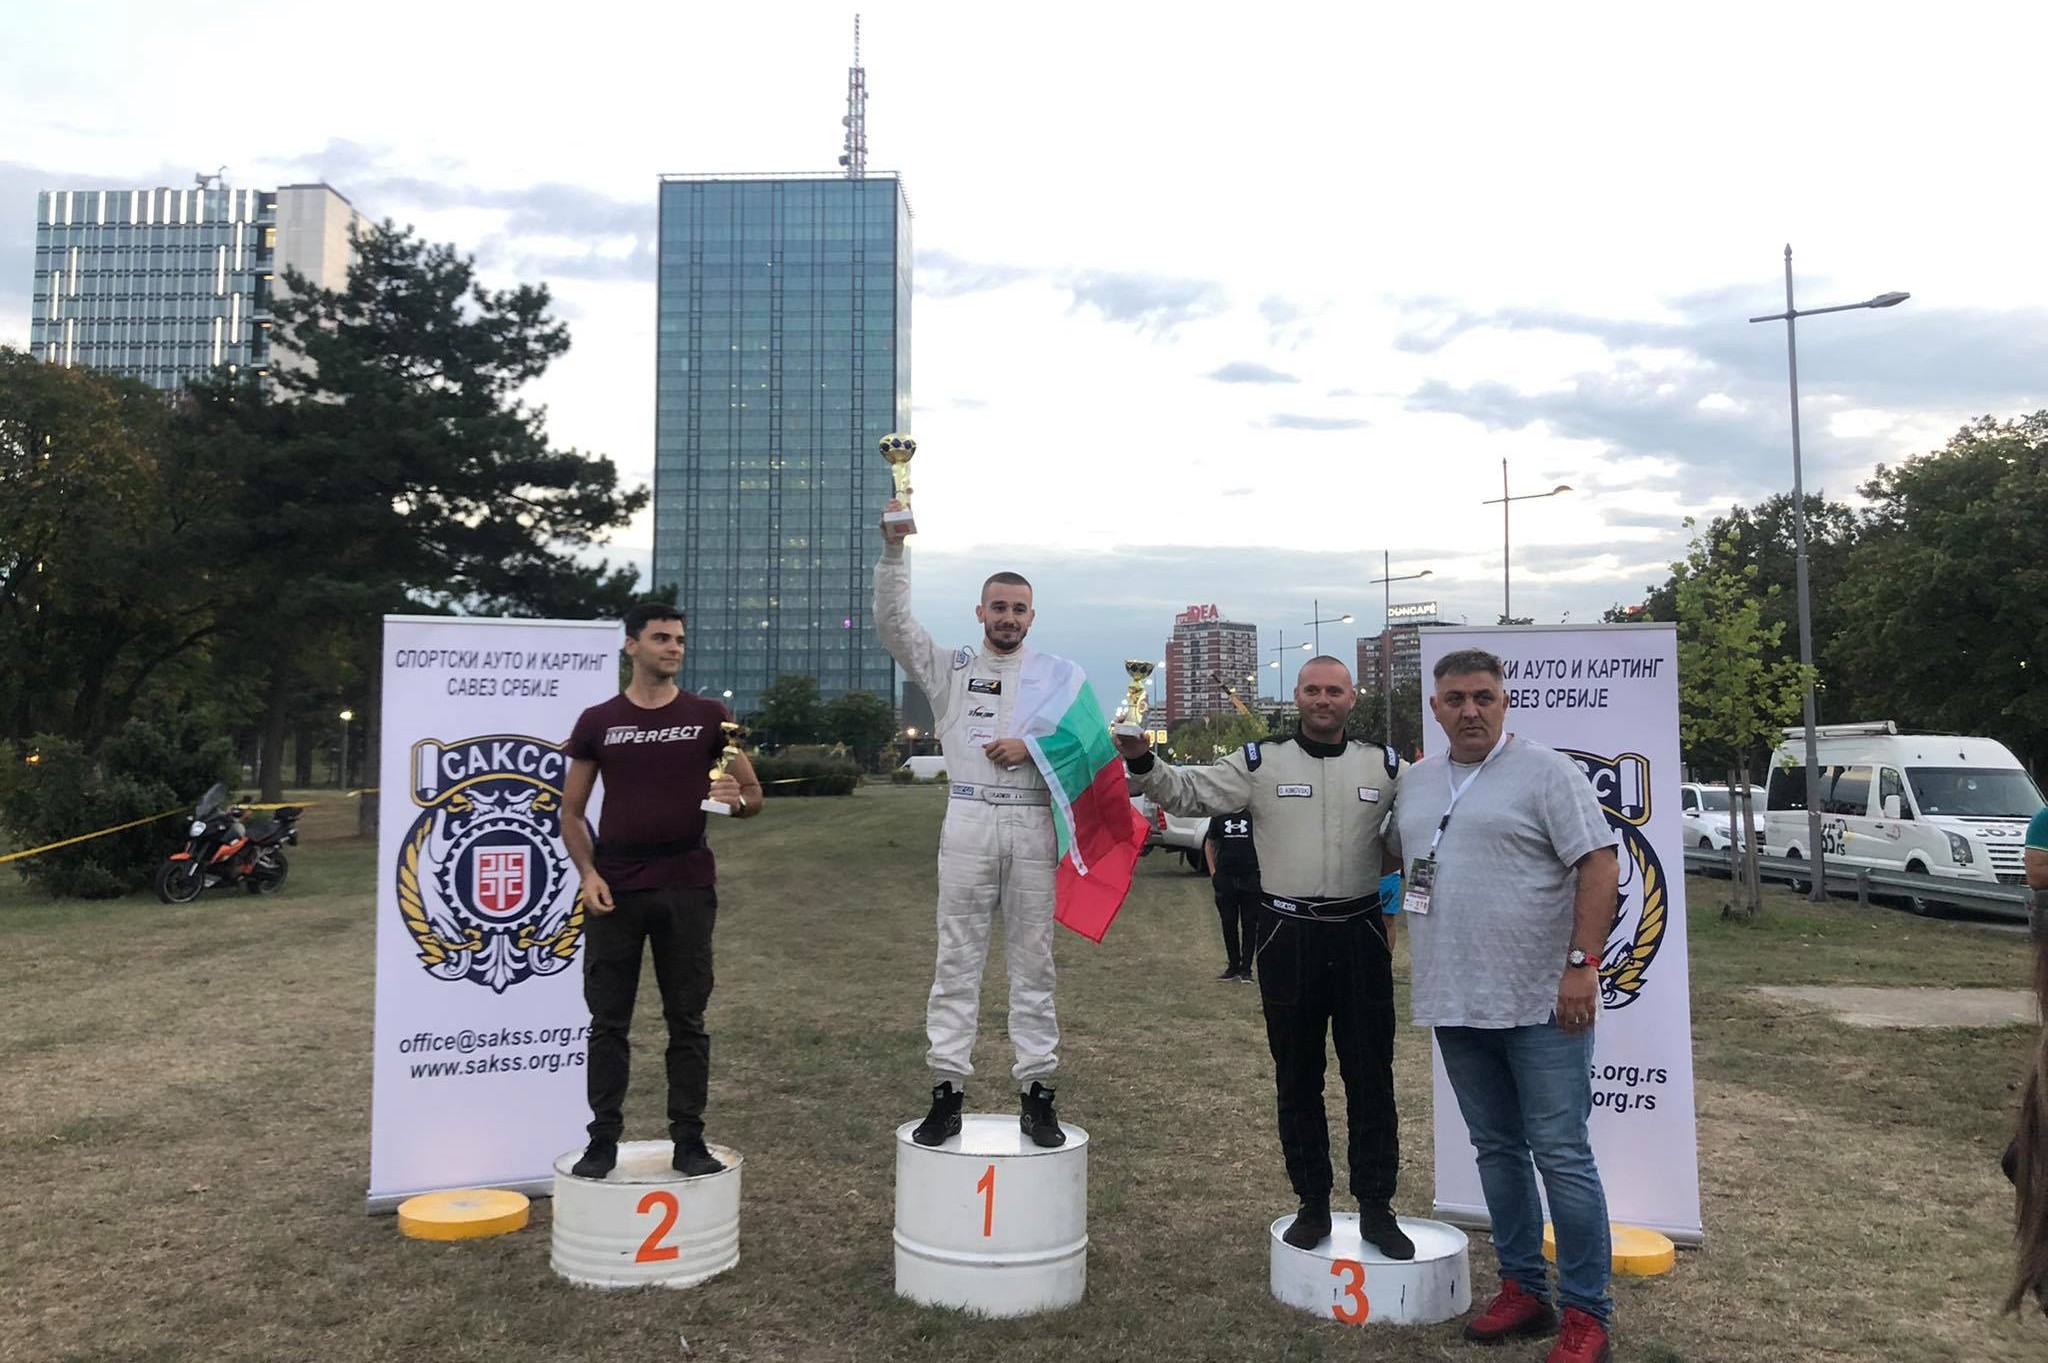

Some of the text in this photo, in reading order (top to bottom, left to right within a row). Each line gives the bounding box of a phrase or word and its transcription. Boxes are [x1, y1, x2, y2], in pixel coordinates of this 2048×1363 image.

[396, 650, 608, 671] СПОРТСКИ АУТО И КАРТИНГ
[1523, 659, 1567, 679] АУТО
[1571, 659, 1582, 678] И
[1587, 658, 1664, 678] КАРТИНГ
[447, 678, 559, 697] САВЕЗ СРБИЈЕ
[1504, 688, 1609, 708] ВЕЗ СРБИЈЕ
[604, 726, 703, 746] IMPERFECT
[443, 742, 562, 780] САКСС
[399, 1026, 593, 1054] office@sakss.org.rs
[410, 1052, 585, 1079] www.sakss.org.rs
[977, 1165, 996, 1237] 1
[635, 1191, 679, 1263] 2
[1331, 1258, 1370, 1324] 3
